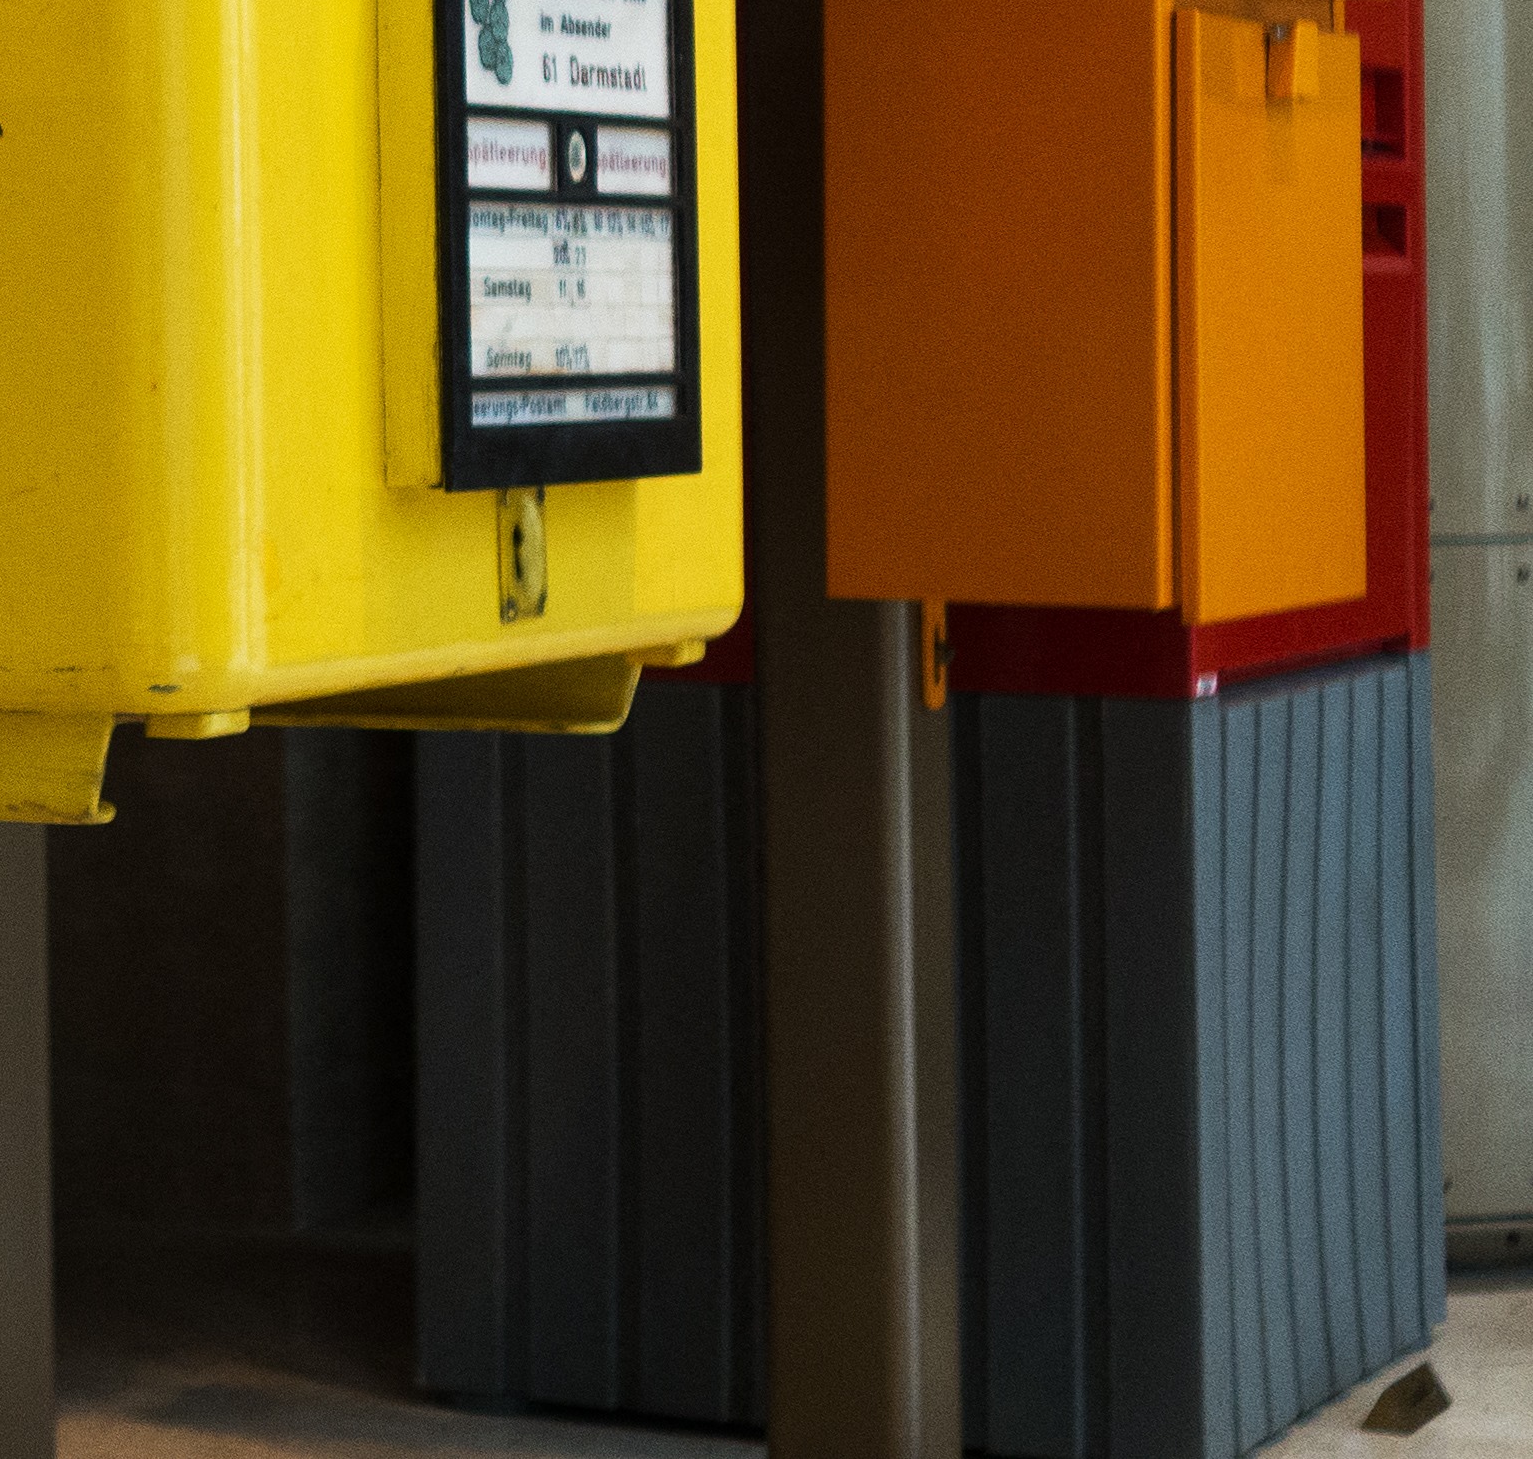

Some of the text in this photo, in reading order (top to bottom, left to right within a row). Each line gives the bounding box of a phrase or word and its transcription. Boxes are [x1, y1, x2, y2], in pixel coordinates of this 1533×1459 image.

[560, 13, 612, 40] Absender
[570, 53, 647, 92] Darmstadt
[598, 150, 667, 178] pätleerung
[472, 208, 548, 235] ontag-Freitag
[483, 275, 532, 305] Samstag
[486, 344, 532, 373] Sonntag
[474, 392, 567, 424] eerungs-Postamt
